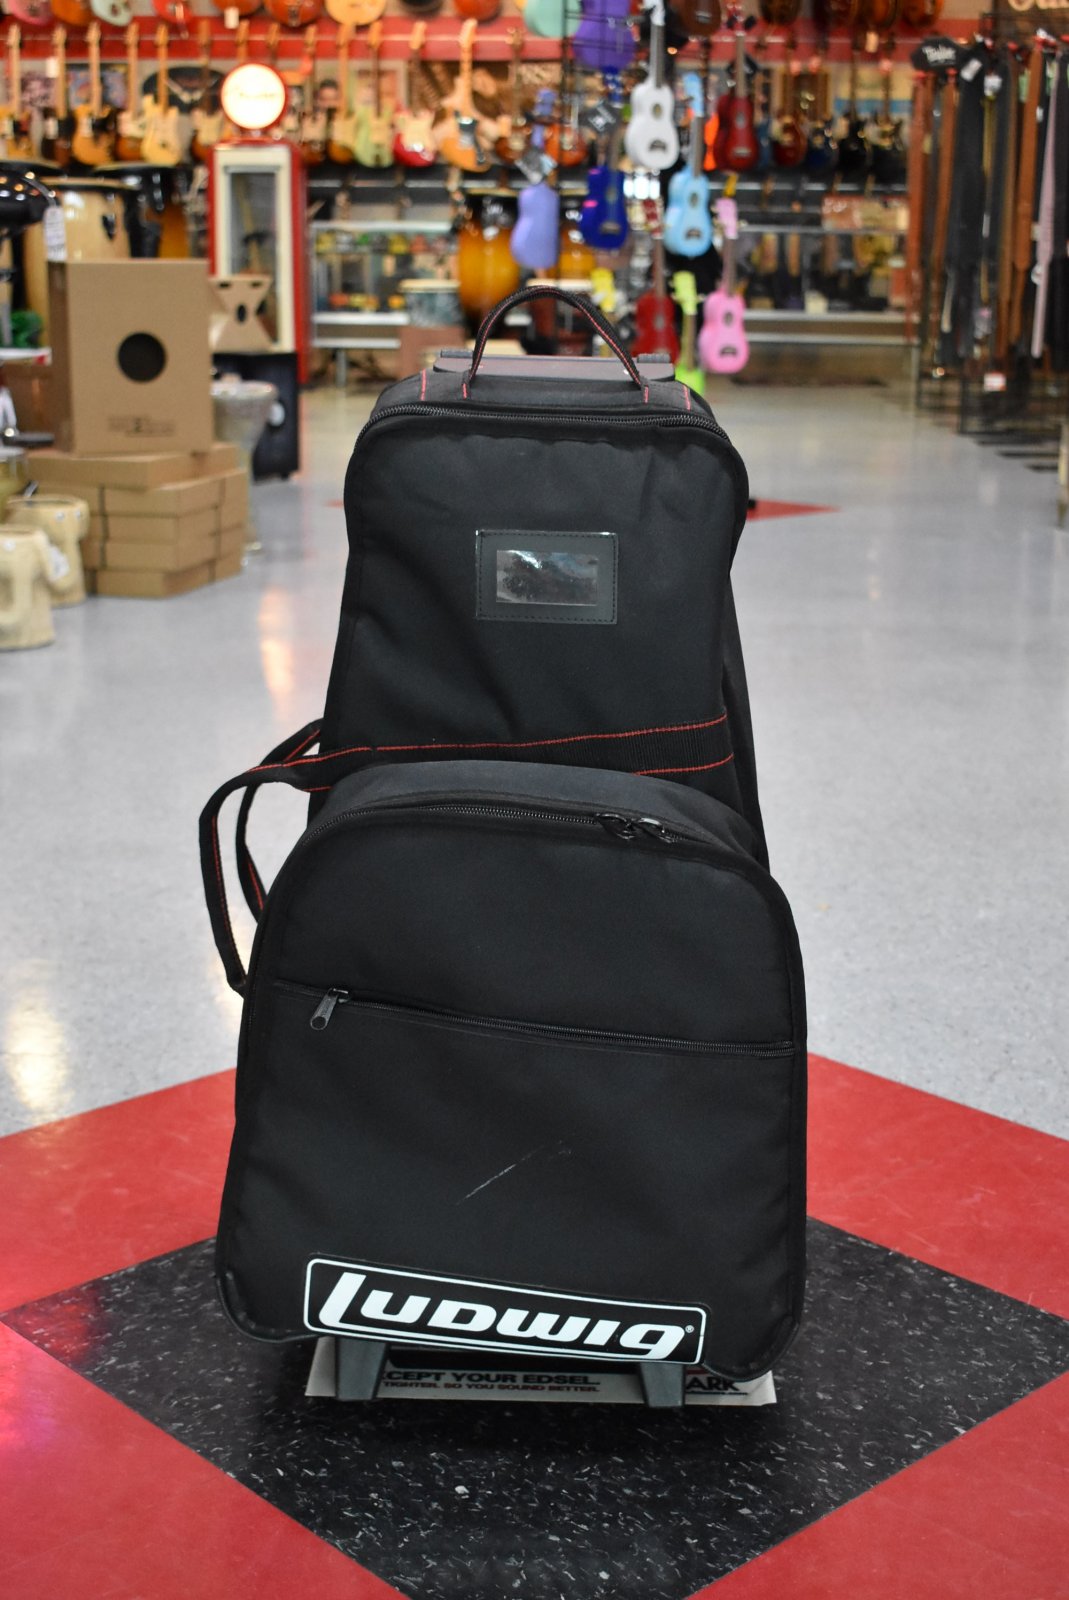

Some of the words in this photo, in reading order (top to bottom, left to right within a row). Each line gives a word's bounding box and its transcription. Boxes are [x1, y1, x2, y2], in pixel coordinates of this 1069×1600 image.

[383, 1371, 446, 1381] CEPT
[451, 1372, 517, 1383] YOUR
[523, 1374, 601, 1385] EDSEL.
[466, 1382, 494, 1390] YOU
[497, 1383, 545, 1391] SOUND
